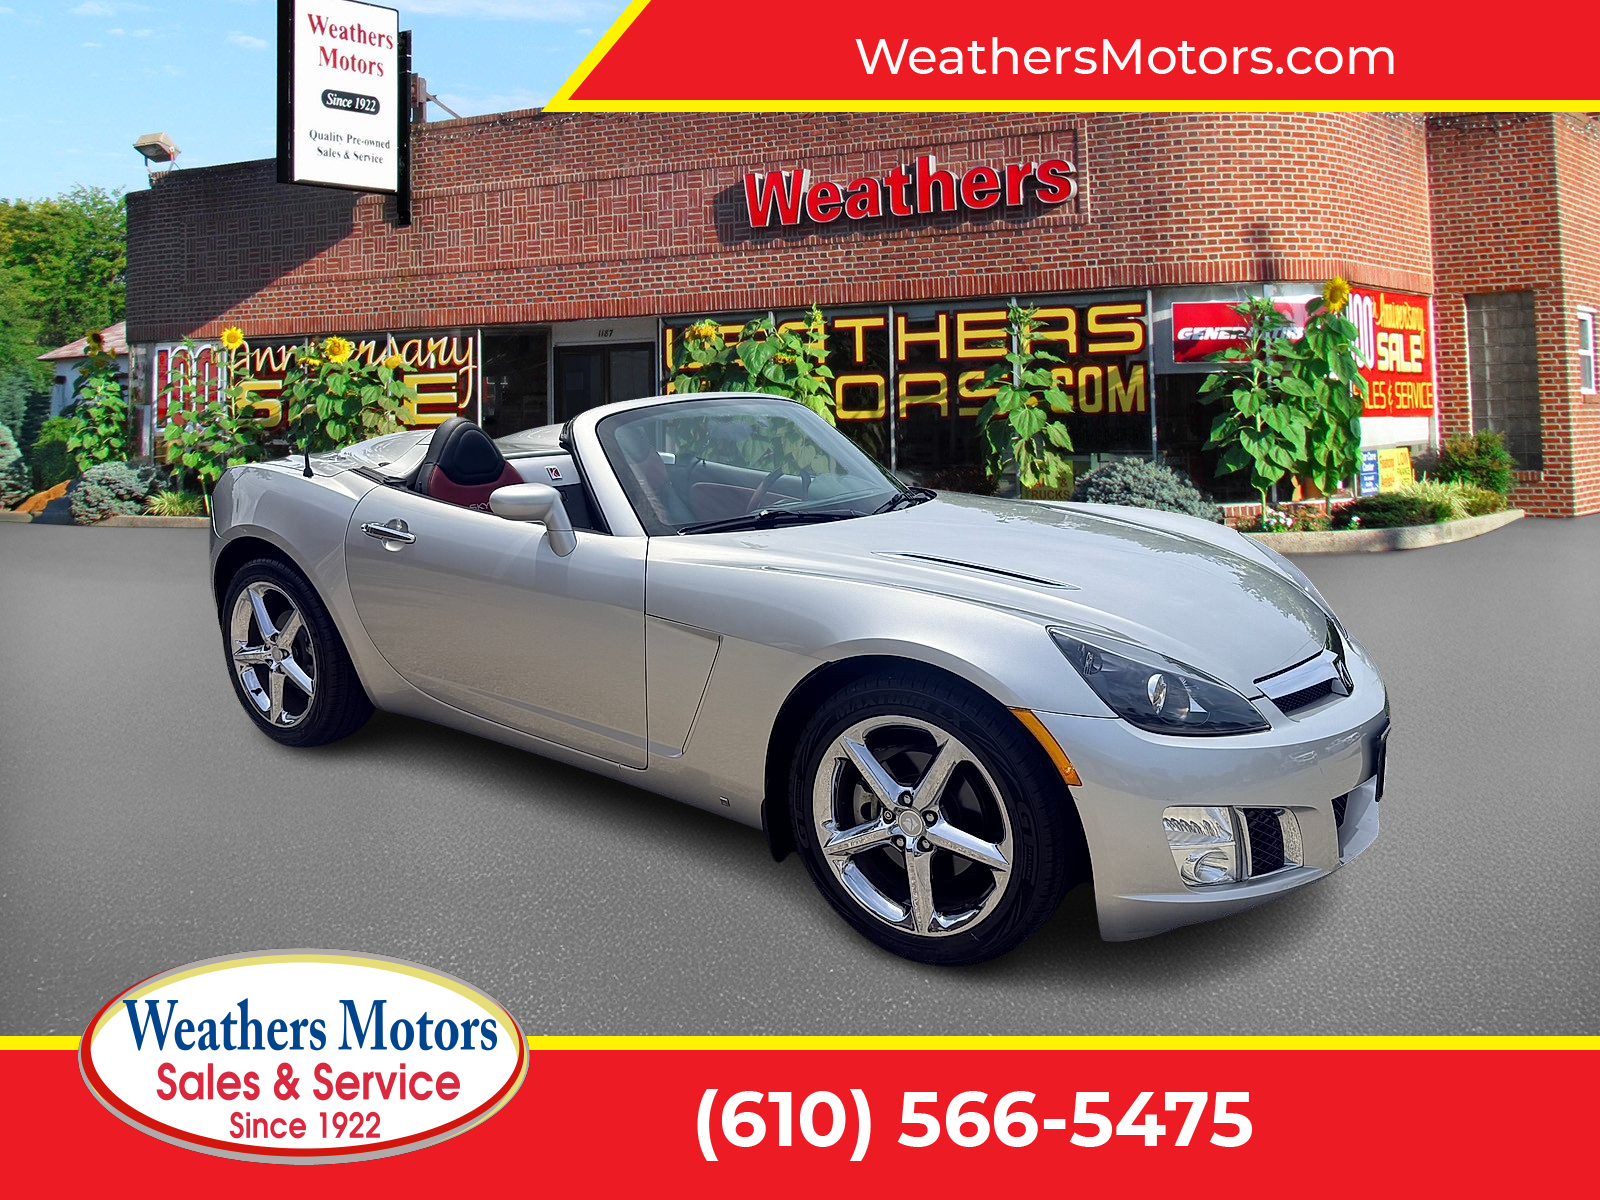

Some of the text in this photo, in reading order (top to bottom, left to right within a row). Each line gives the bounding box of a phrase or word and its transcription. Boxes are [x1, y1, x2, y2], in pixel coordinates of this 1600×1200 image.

[307, 13, 394, 50] Weathers
[318, 46, 385, 77] Motors
[326, 92, 376, 112] Since 1922
[309, 129, 391, 150] Quality Pre-owned
[316, 147, 384, 164] Sales & Service
[743, 154, 1078, 228] Weathers
[598, 329, 614, 337] 1187
[1377, 332, 1423, 373] SALE
[1353, 379, 1434, 413] LES & SERVICE
